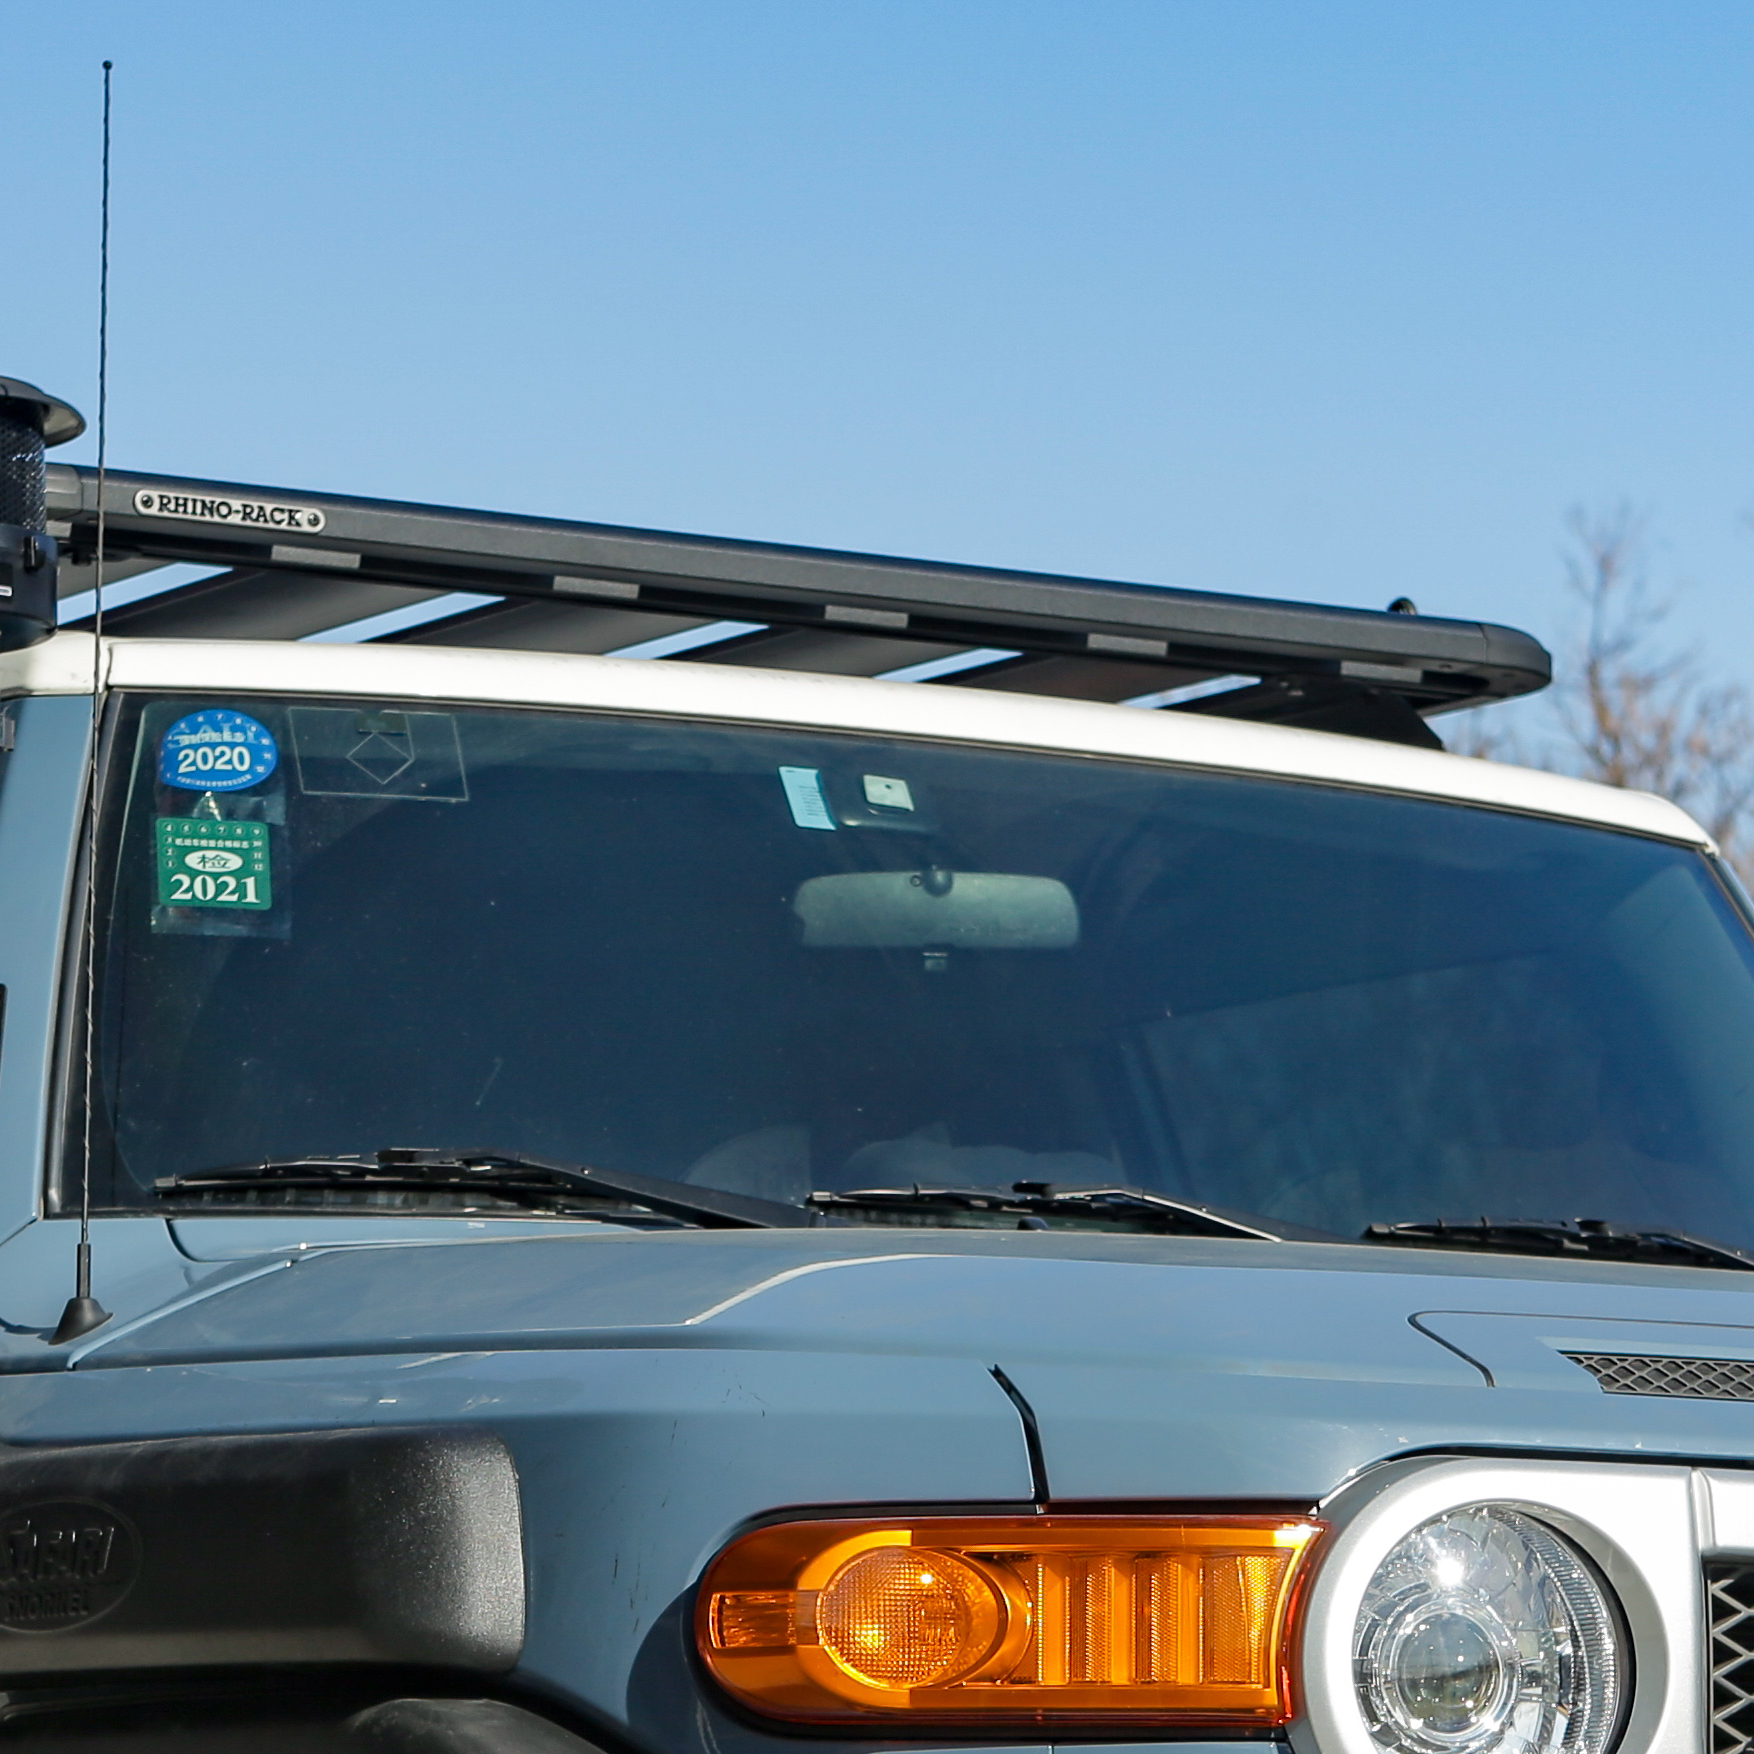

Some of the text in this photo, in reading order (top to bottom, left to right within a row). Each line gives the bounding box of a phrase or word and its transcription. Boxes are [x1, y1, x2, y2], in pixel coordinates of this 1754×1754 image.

[157, 494, 304, 527] RHINO-RACK
[177, 745, 251, 774] 2020
[169, 873, 261, 904] 2021
